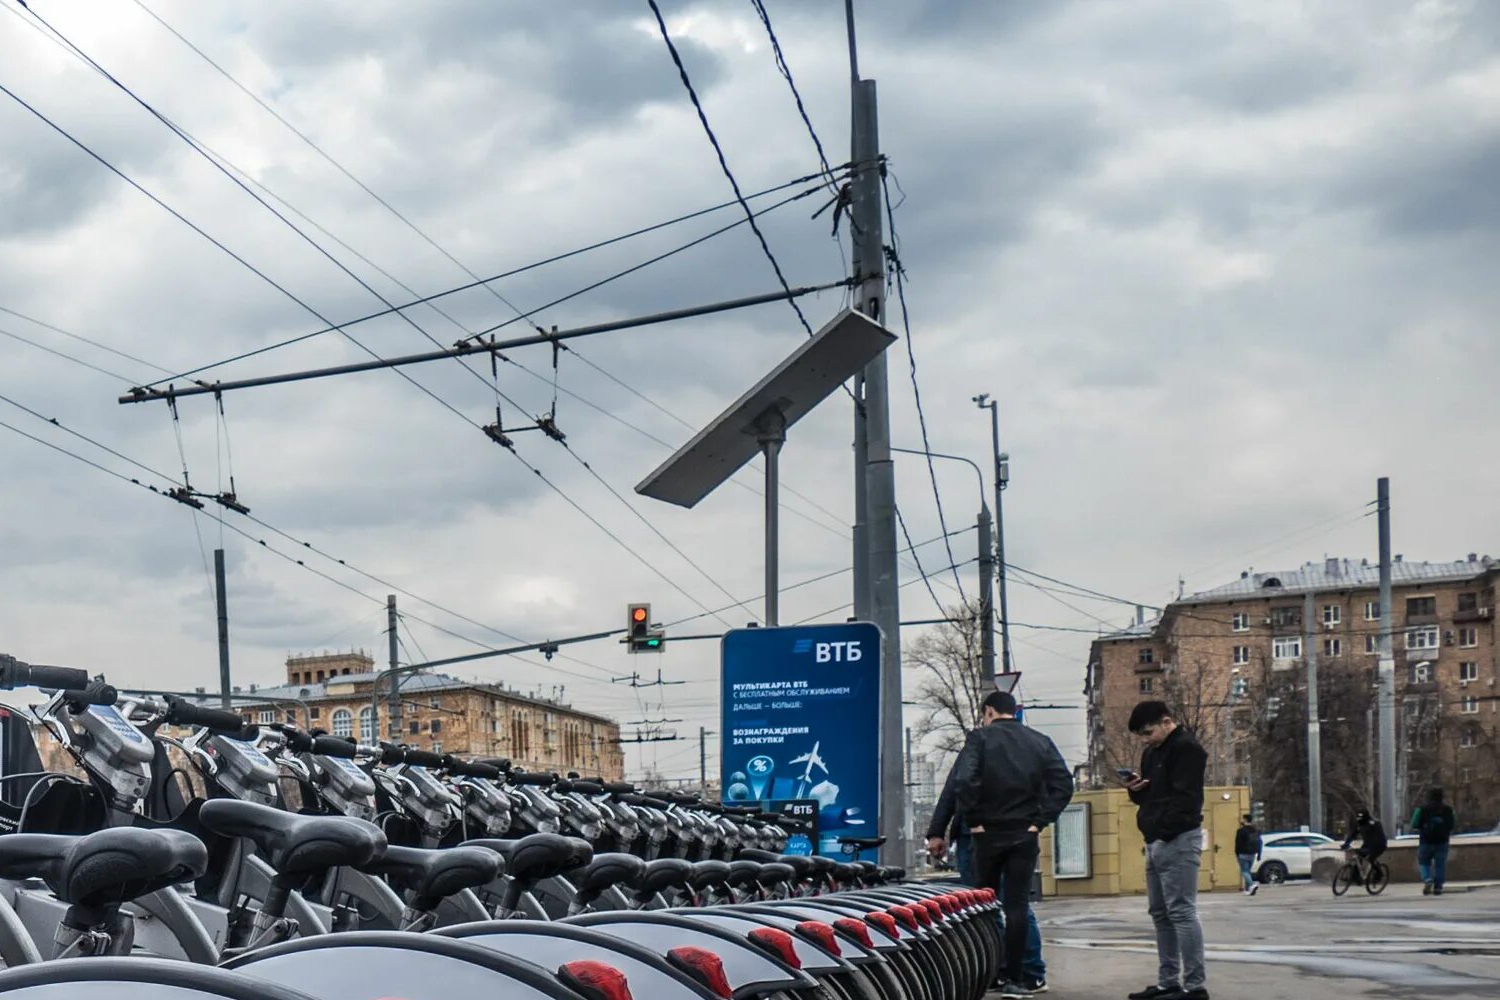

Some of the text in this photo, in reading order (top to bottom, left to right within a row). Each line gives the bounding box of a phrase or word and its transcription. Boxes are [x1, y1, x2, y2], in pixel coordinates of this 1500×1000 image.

[816, 641, 862, 663] ВТБ
[733, 681, 808, 691] МУЛЬТИКАРТА ВТБ
[739, 689, 786, 699] БЕСПЛАТНЫМ
[786, 687, 851, 697] ОБСЛУЖИВАНИЕМ
[733, 703, 763, 712] ДАЛЬШЕ
[732, 727, 810, 737] ВОЗНАГРАЖДЕНИЯ
[733, 736, 785, 746] ЗА ПОКУПКИ
[793, 805, 813, 815] ВТБ
